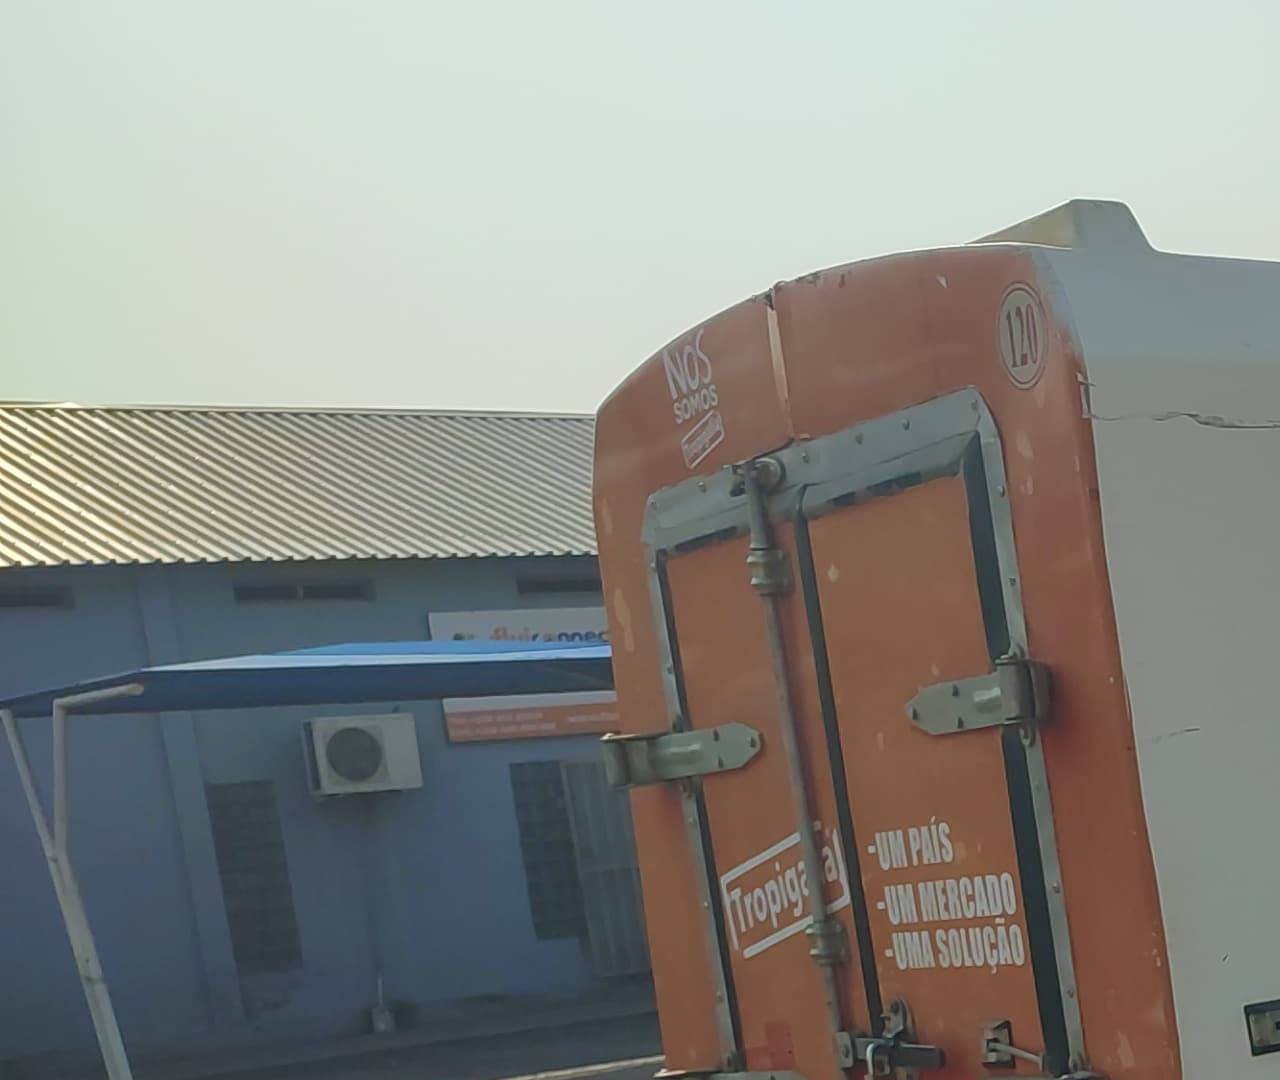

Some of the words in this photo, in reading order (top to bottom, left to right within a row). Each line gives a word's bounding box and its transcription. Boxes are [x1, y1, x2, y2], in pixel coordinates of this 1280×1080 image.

[1006, 303, 1038, 368] 120
[673, 384, 718, 424] SOMOS
[909, 816, 954, 865] PAÍS
[917, 872, 1017, 924] MERCADO
[935, 918, 1025, 973] SOLUÇÃO
